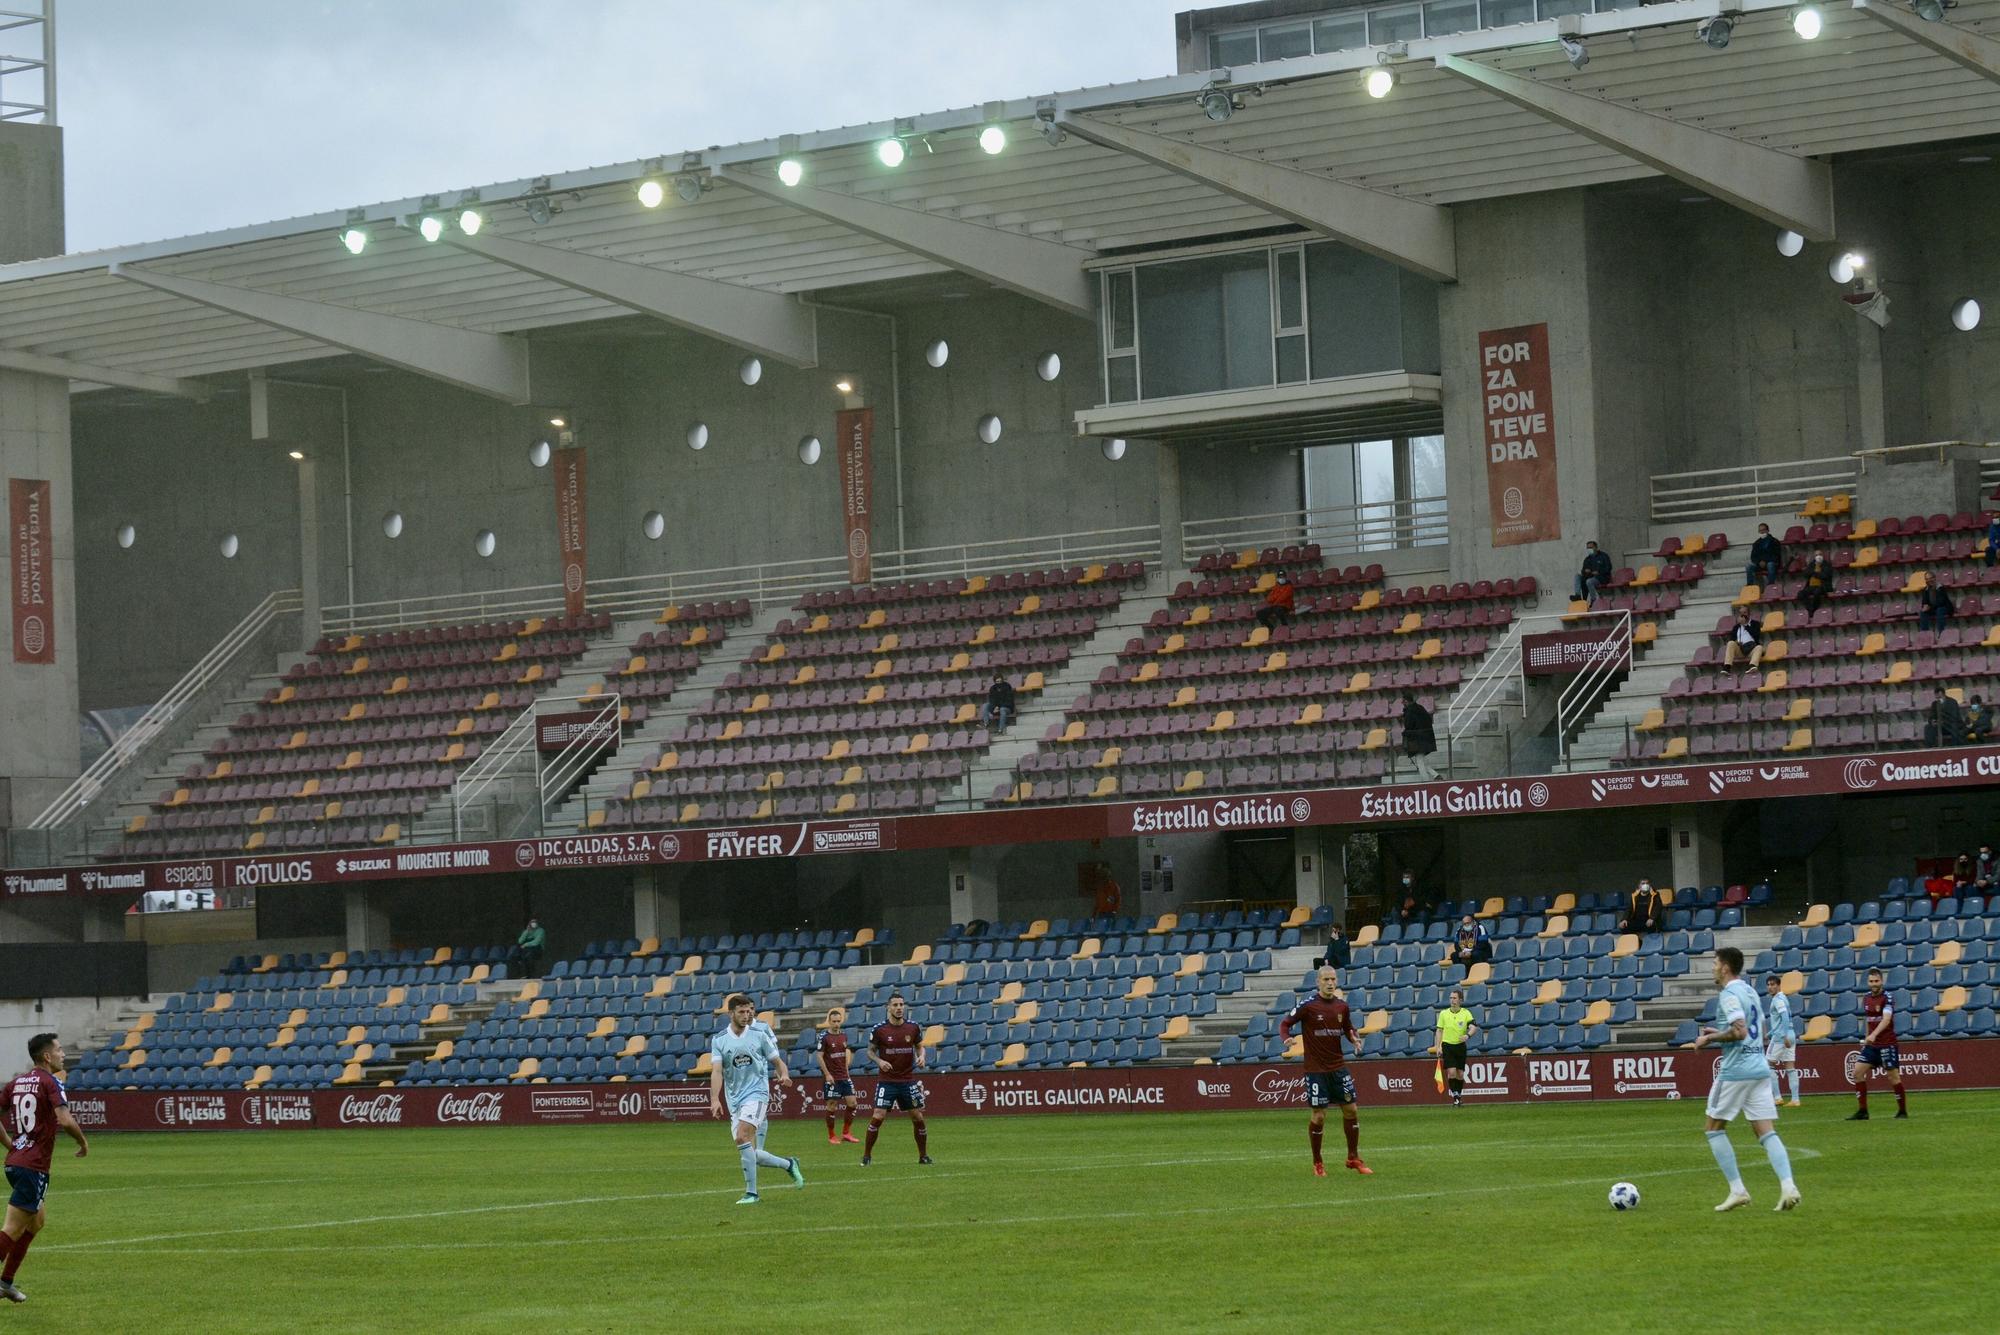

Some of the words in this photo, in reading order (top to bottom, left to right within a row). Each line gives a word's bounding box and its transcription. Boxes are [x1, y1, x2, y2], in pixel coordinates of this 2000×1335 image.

[1485, 342, 1530, 366] FOR
[1487, 369, 1517, 390] ZA
[1488, 391, 1535, 414] PON
[1489, 413, 1547, 438] TEVE
[1491, 439, 1538, 463] DRA
[854, 422, 867, 515] PONTEVEDRA
[568, 462, 582, 552] PONTEVEDRA
[28, 490, 44, 605] PONTEVEDRA
[1726, 768, 1754, 776] DEPORTE
[1882, 758, 1969, 781] Comercial
[1360, 789, 1442, 817] Estrella
[1446, 783, 1523, 812] Galicia
[1132, 804, 1209, 832] Estrella
[1213, 798, 1286, 827] Galicia
[538, 841, 562, 857] IDC
[565, 837, 624, 856] CALDAS,
[627, 836, 656, 851] S.A.
[707, 835, 783, 858] FAYFER
[828, 831, 877, 842] EUROMASTER
[349, 859, 391, 871] SUZUKI
[397, 852, 451, 870] MOURENTE
[454, 850, 490, 867] MOTOR
[545, 856, 584, 867] ENVAXES
[588, 856, 593, 864] E
[597, 853, 650, 864] EMBALAXES
[20, 874, 67, 892] hummel
[97, 870, 145, 889] hummel
[165, 861, 213, 888] espacio
[235, 860, 312, 886] RÓTULOS
[1463, 1062, 1508, 1084] ROIZ
[1529, 1060, 1591, 1082] FROIZ
[1613, 1057, 1675, 1079] FROIZ
[1872, 1064, 1955, 1079] POTEVEDRA
[878, 1087, 885, 1098] 8
[1207, 1083, 1231, 1094] ence
[1312, 1082, 1319, 1096] 9
[1388, 1078, 1413, 1088] ence
[437, 1092, 504, 1122] Coca-Cola
[535, 1096, 590, 1107] PONTEVEDRESA
[619, 1092, 642, 1116] 60
[652, 1094, 709, 1104] PONTEVEDRESA
[994, 1090, 1042, 1106] HOTEL
[1045, 1088, 1105, 1105] GALICIA
[1108, 1087, 1165, 1104] PALACE
[13, 1093, 37, 1134] 18
[340, 1094, 404, 1123] Coca-Cola
